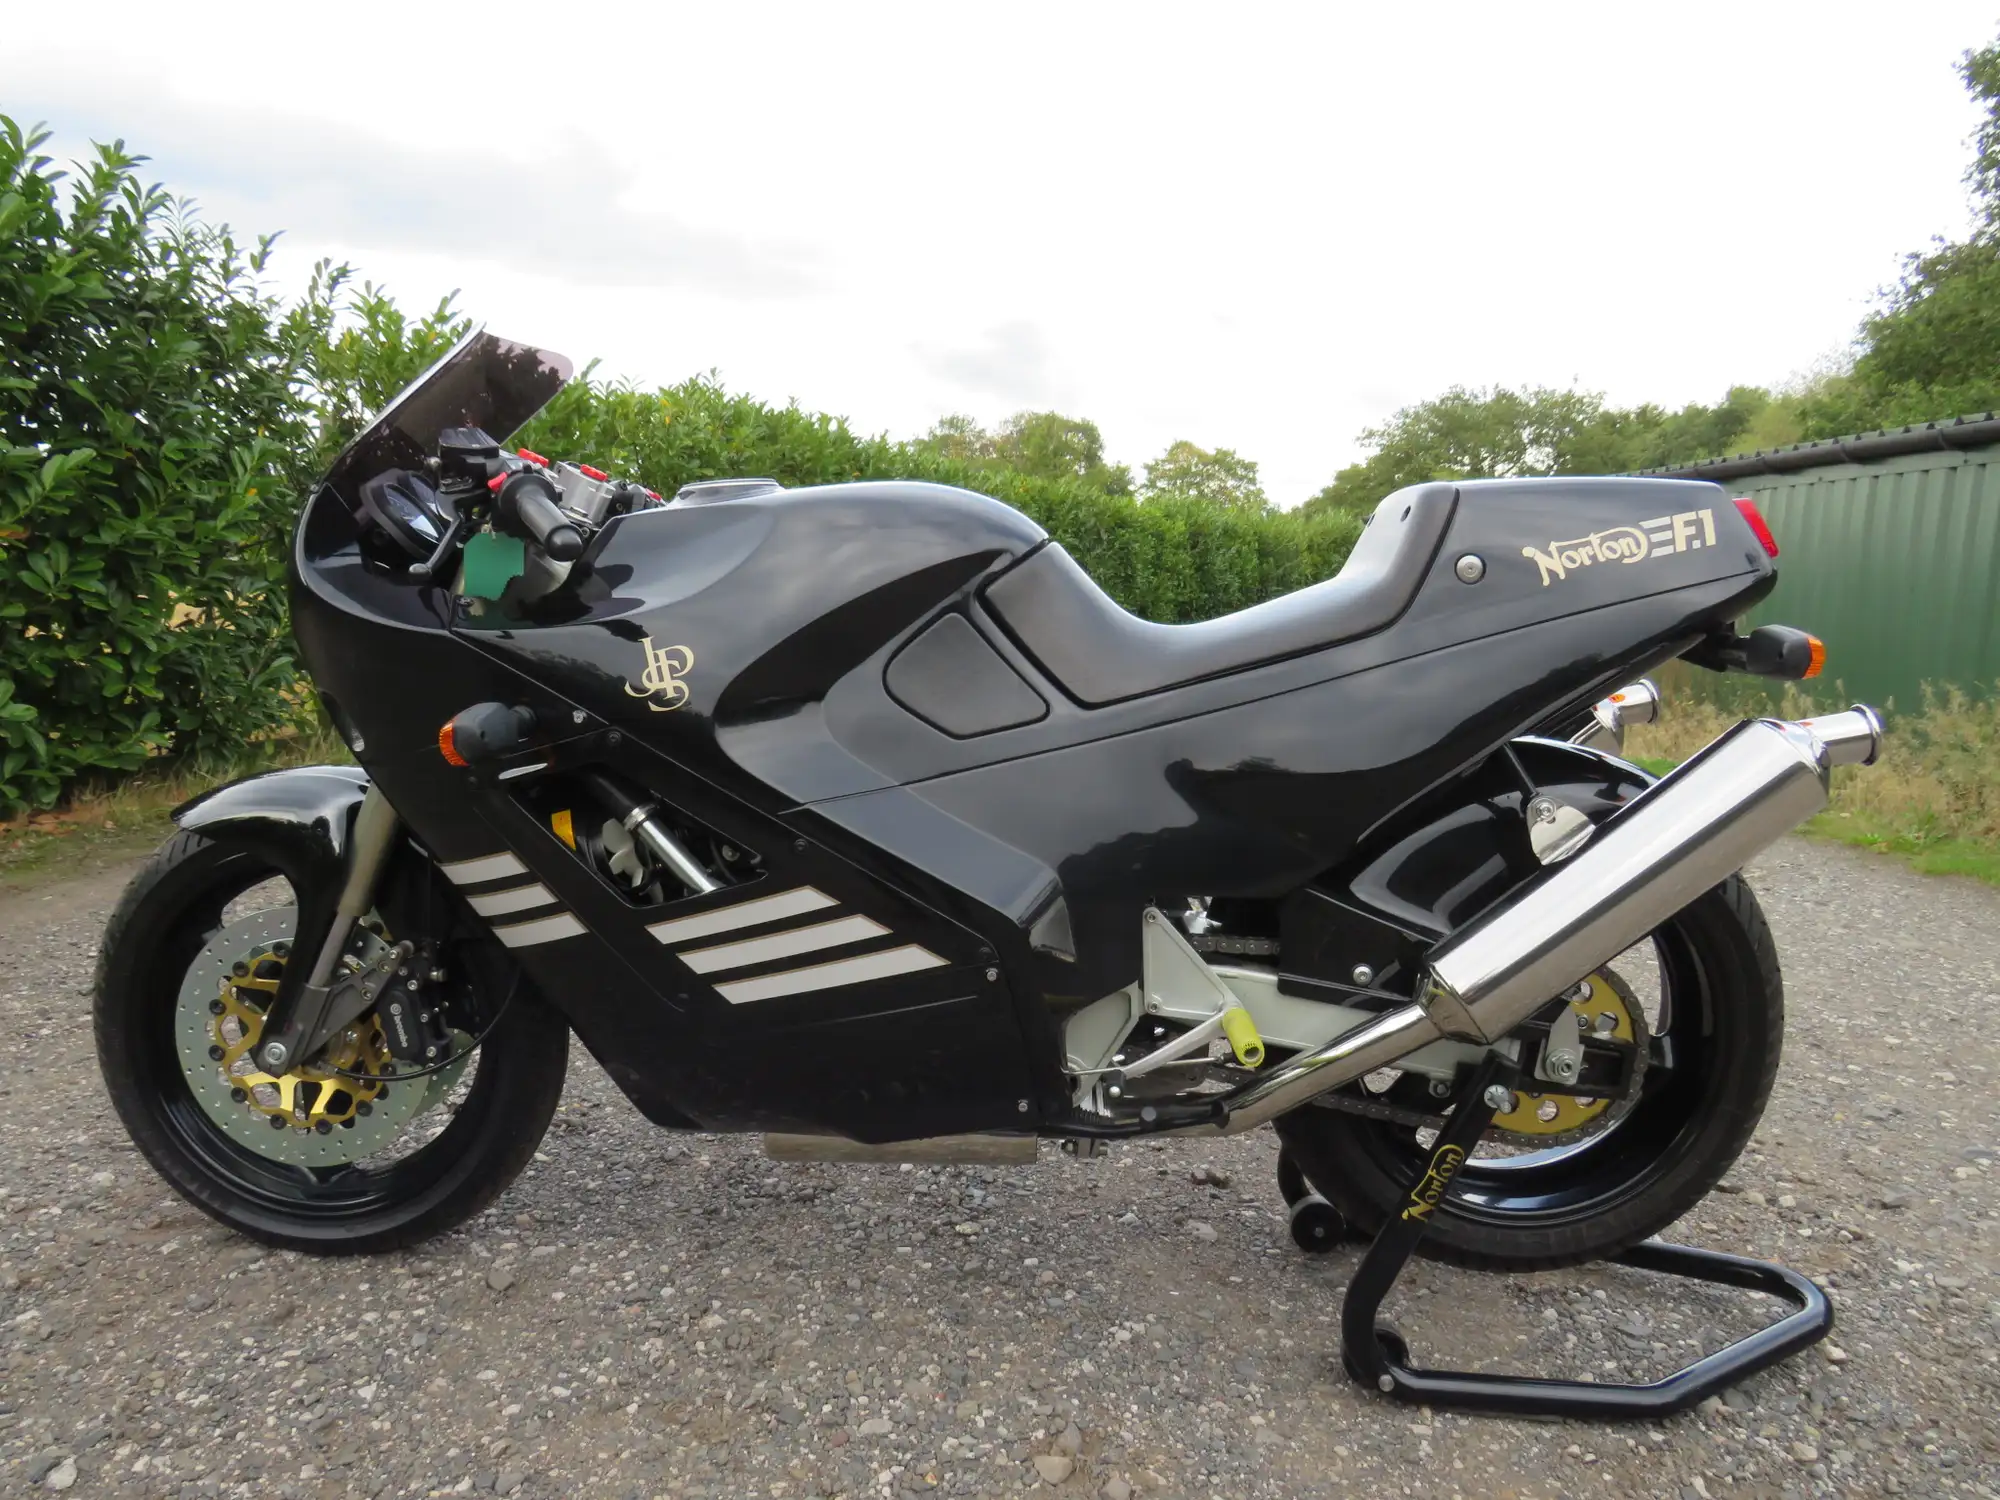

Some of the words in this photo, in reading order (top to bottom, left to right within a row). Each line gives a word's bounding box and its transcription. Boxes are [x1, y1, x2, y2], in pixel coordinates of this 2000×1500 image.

[1522, 526, 1648, 586] Norton
[394, 1015, 408, 1047] brembo
[1401, 1144, 1464, 1223] Norton
